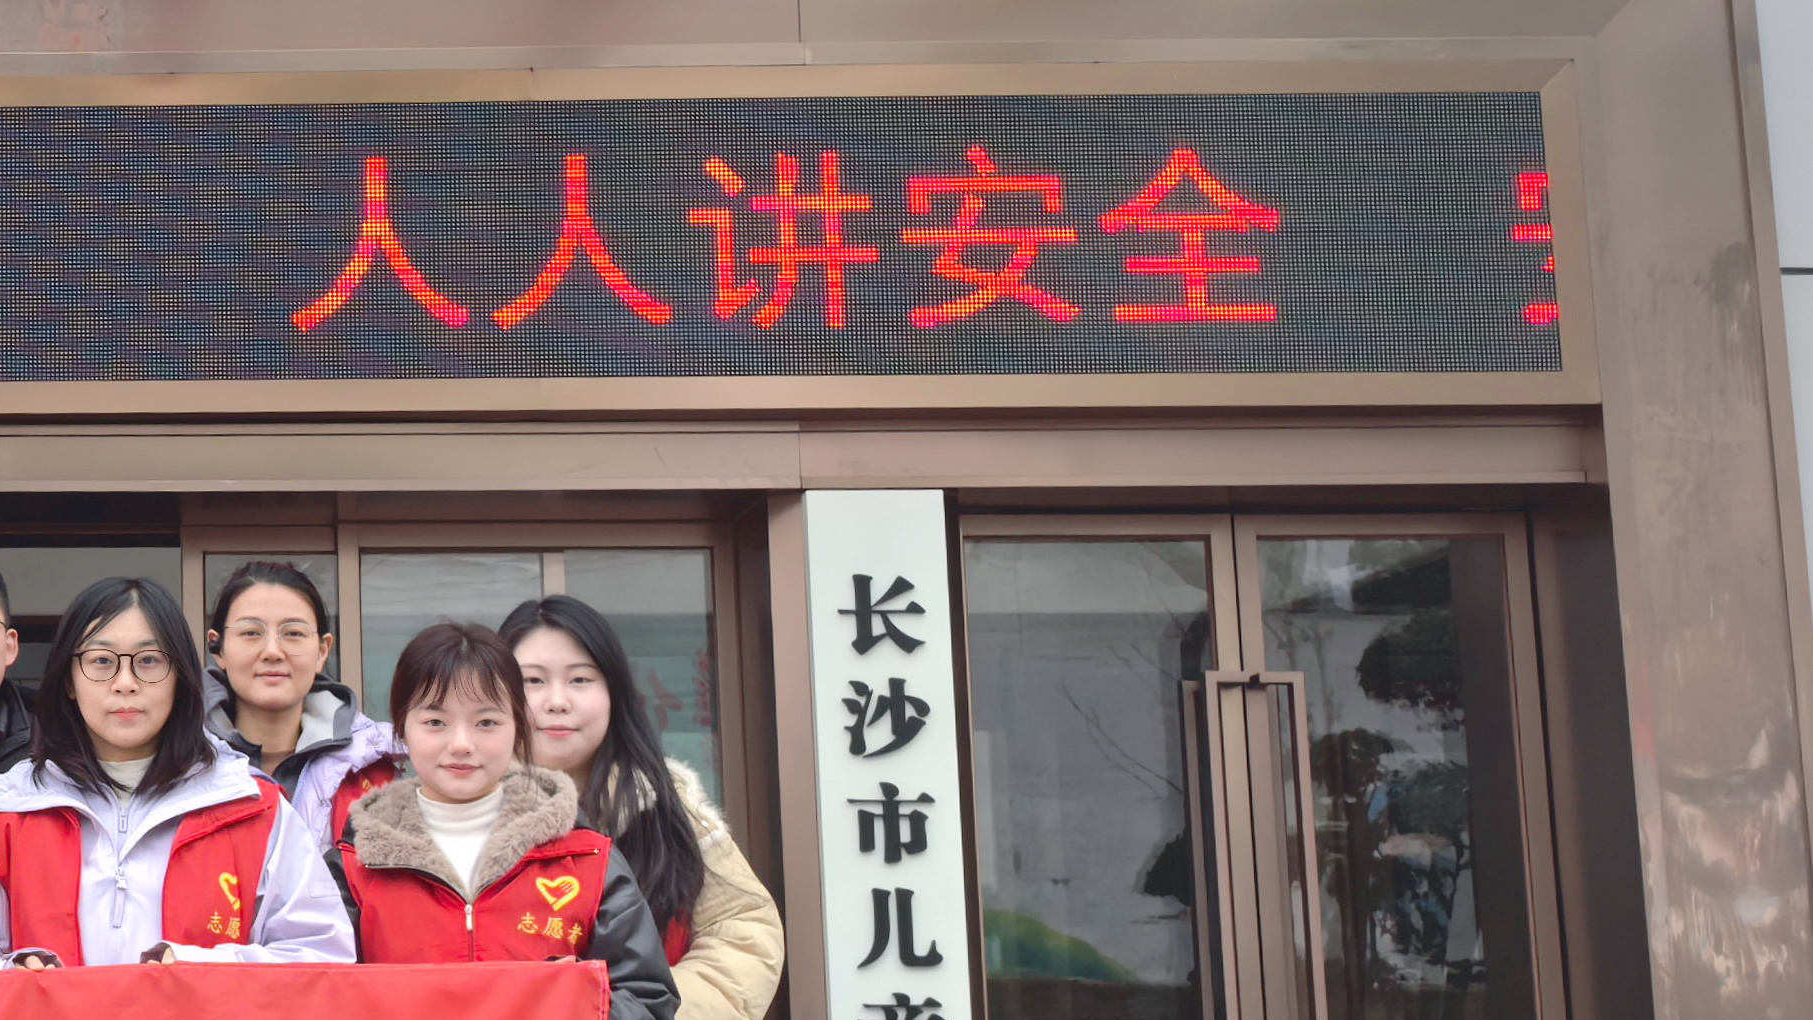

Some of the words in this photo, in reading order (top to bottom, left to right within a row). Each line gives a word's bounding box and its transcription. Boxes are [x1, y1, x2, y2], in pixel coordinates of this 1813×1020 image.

[291, 147, 1281, 330] 人人讲安全
[517, 911, 583, 945] 志愿者
